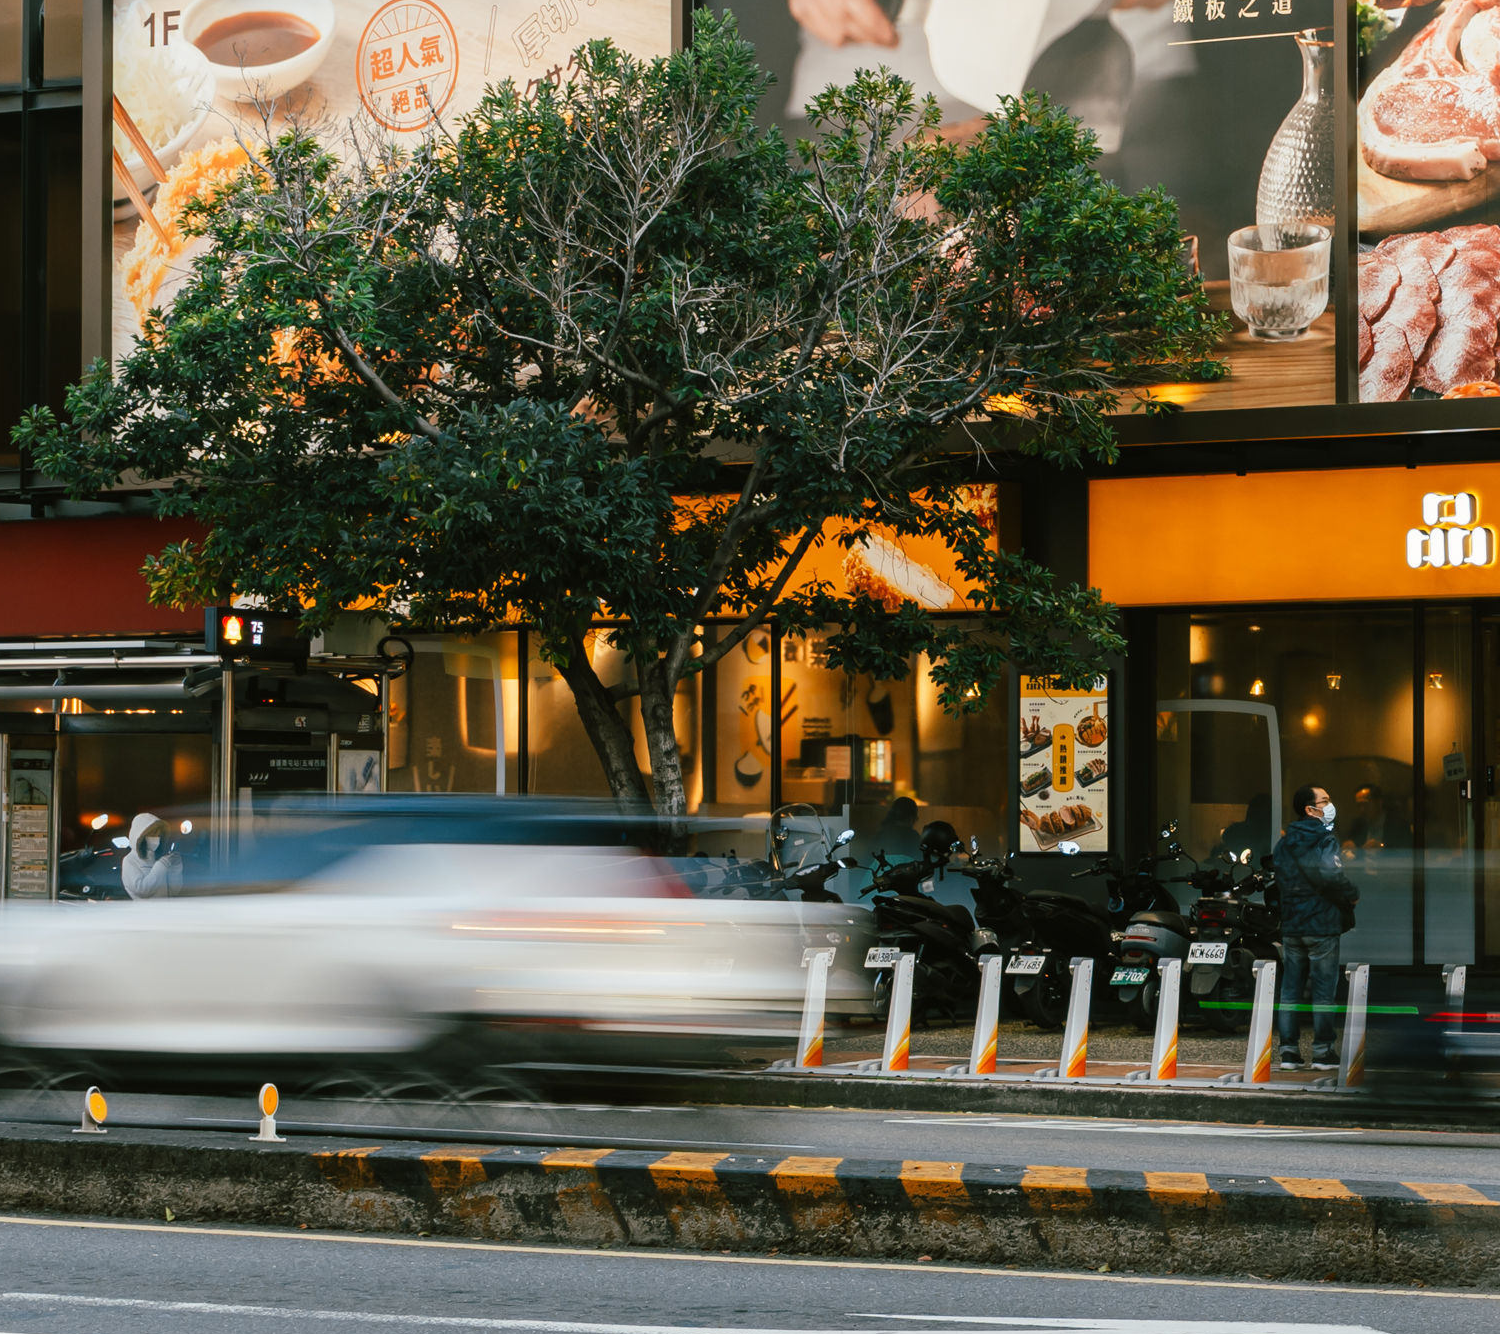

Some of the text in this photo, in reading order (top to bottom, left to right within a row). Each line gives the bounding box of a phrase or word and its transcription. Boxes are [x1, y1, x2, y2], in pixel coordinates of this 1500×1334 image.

[142, 8, 183, 49] 1F
[369, 34, 445, 83] 超人氣
[390, 83, 430, 116] 絕品
[250, 620, 264, 634] 75
